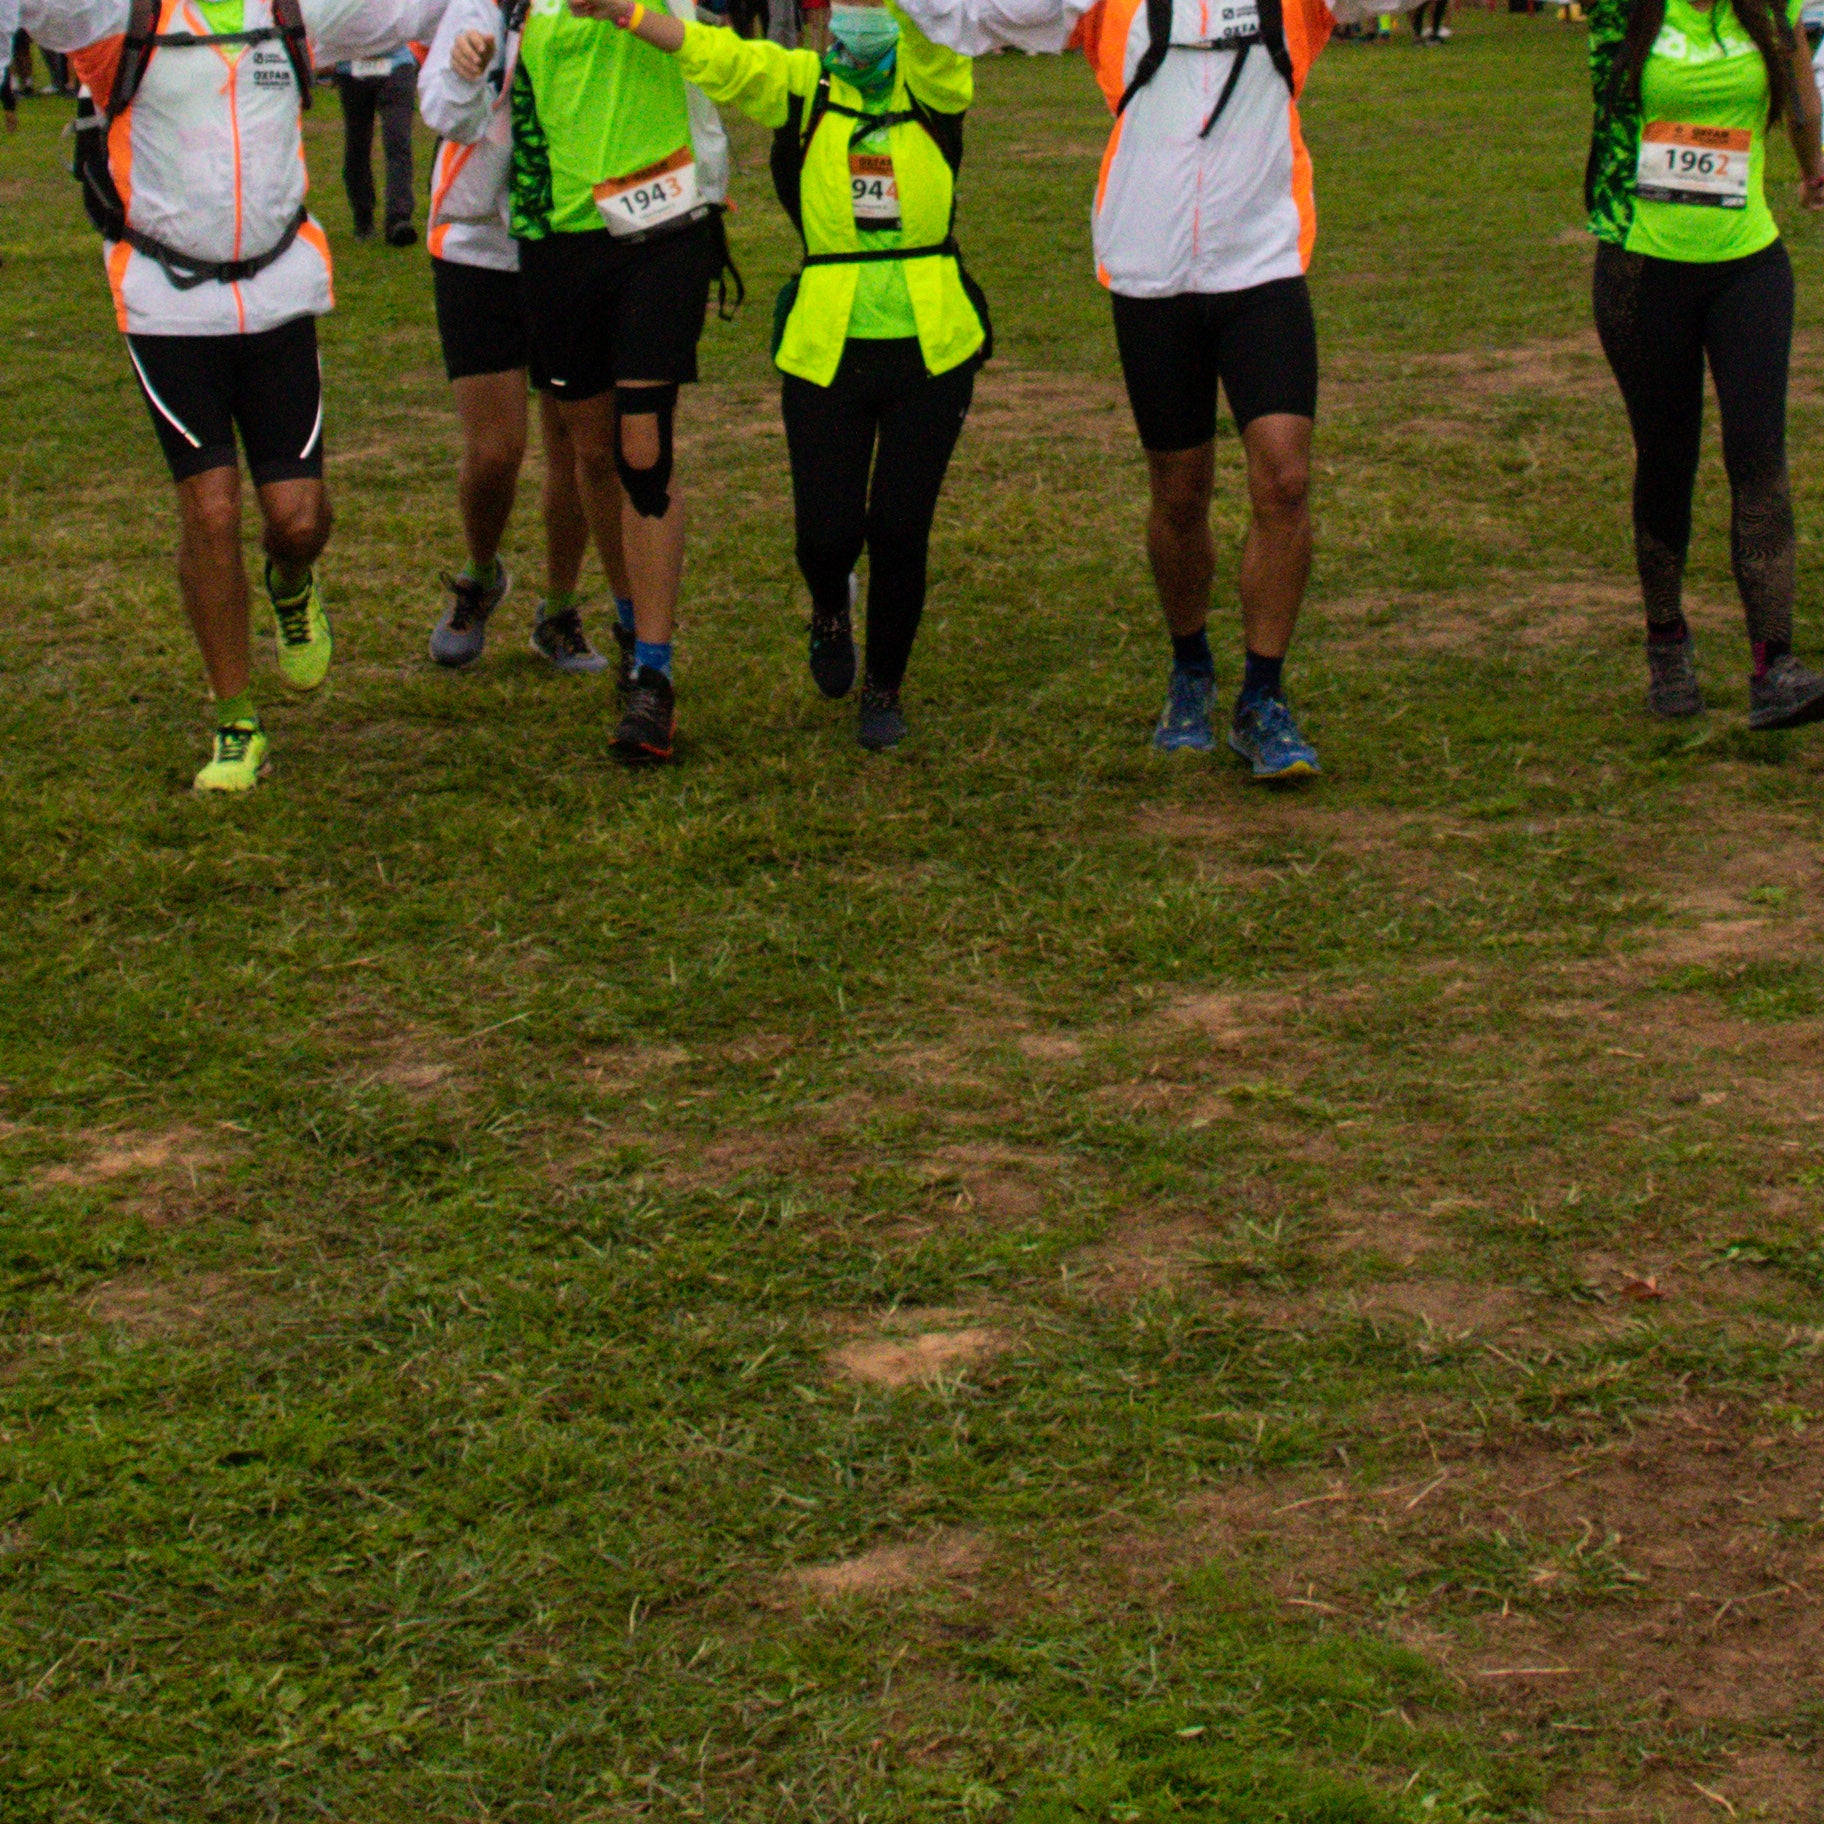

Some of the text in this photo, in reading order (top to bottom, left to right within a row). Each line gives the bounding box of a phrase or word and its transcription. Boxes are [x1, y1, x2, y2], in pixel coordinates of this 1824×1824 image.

[1664, 148, 1730, 177] 1962
[619, 177, 683, 215] 1943
[851, 179, 899, 202] 944
